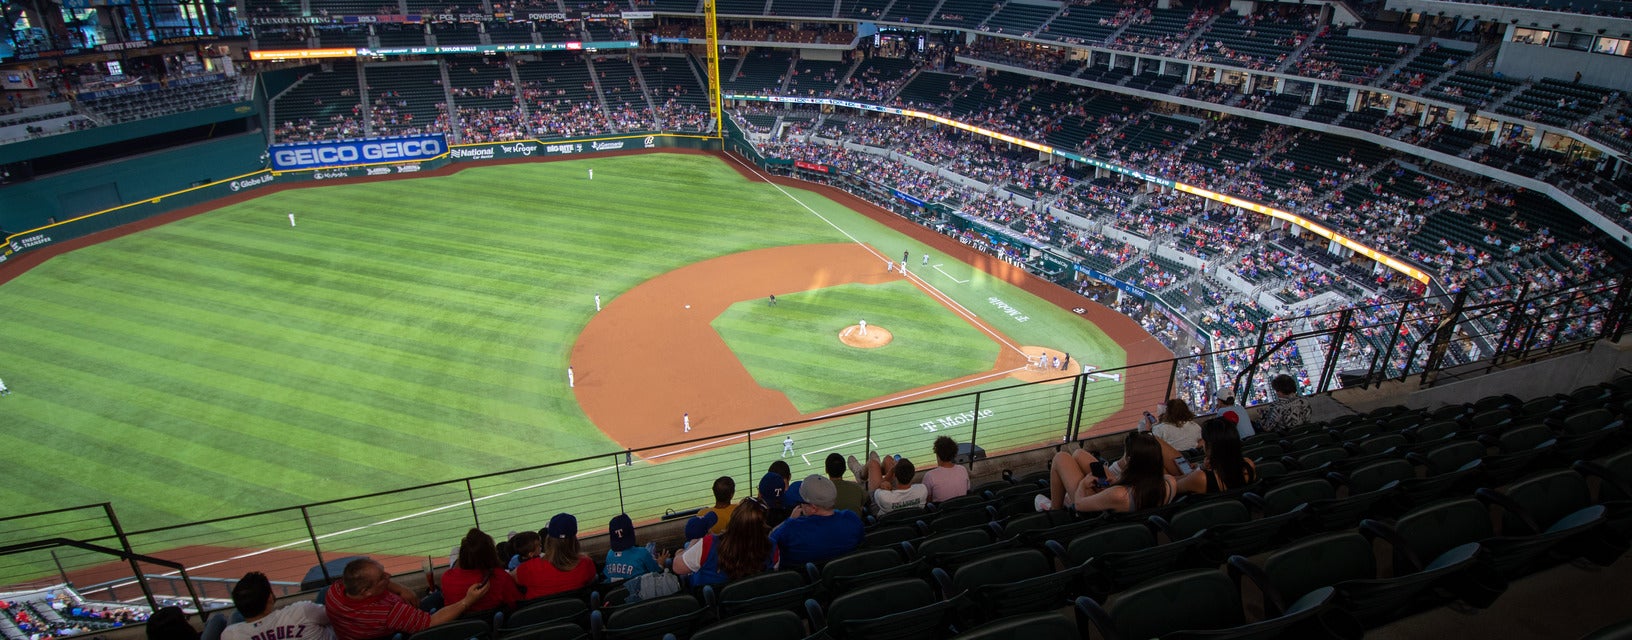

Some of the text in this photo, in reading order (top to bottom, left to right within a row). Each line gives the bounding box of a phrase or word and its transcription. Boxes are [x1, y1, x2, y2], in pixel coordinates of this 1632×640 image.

[291, 16, 330, 24] STAFFING
[275, 139, 441, 167] GEICO GEICO
[461, 147, 494, 157] National
[513, 142, 538, 156] Kroger
[240, 174, 274, 188] Globe Life
[21, 234, 43, 244] ENERGY
[23, 236, 52, 248] TRANSFER
[774, 487, 783, 498] T
[614, 528, 623, 538] T
